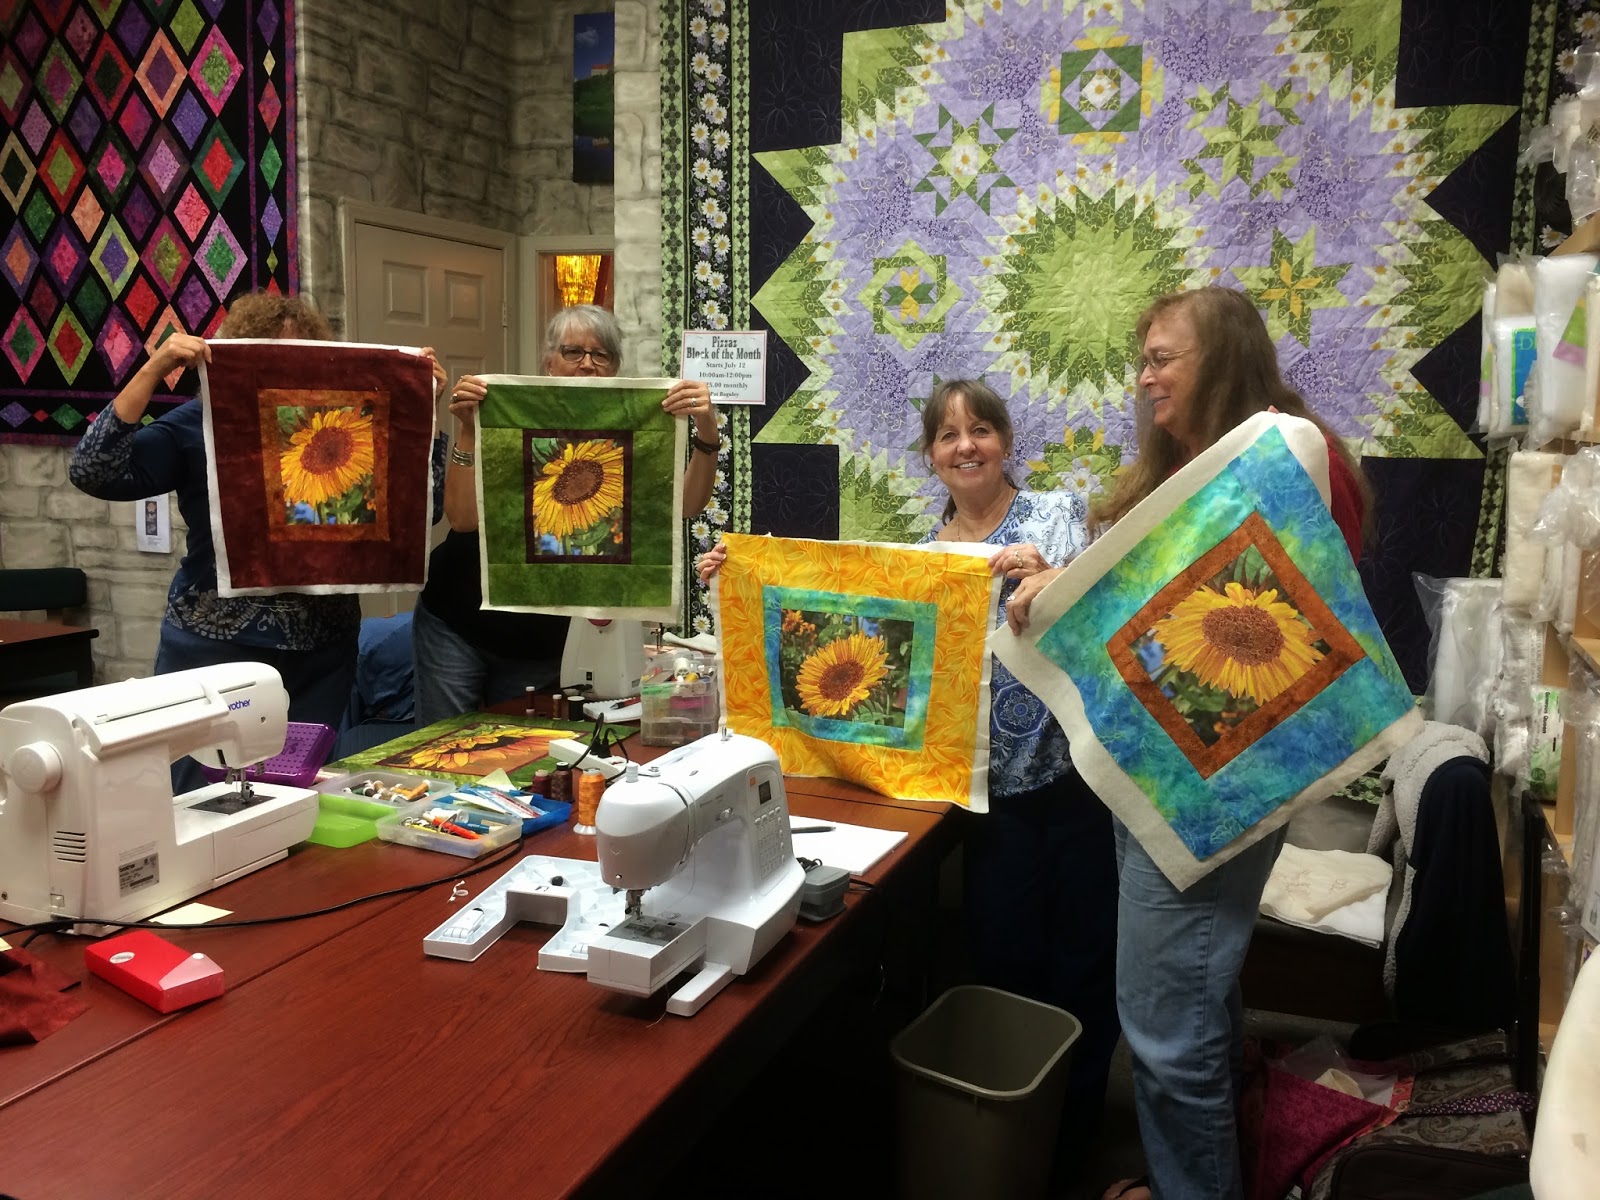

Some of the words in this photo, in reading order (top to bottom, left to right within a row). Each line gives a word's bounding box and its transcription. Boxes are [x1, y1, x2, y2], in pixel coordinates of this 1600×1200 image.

[712, 336, 737, 348] Pizzaz
[686, 347, 709, 359] Block
[711, 348, 720, 359] of
[722, 348, 734, 359] the
[736, 348, 761, 360] Month
[699, 372, 752, 380] 10:00am-12:00pm
[228, 699, 250, 711] rother
